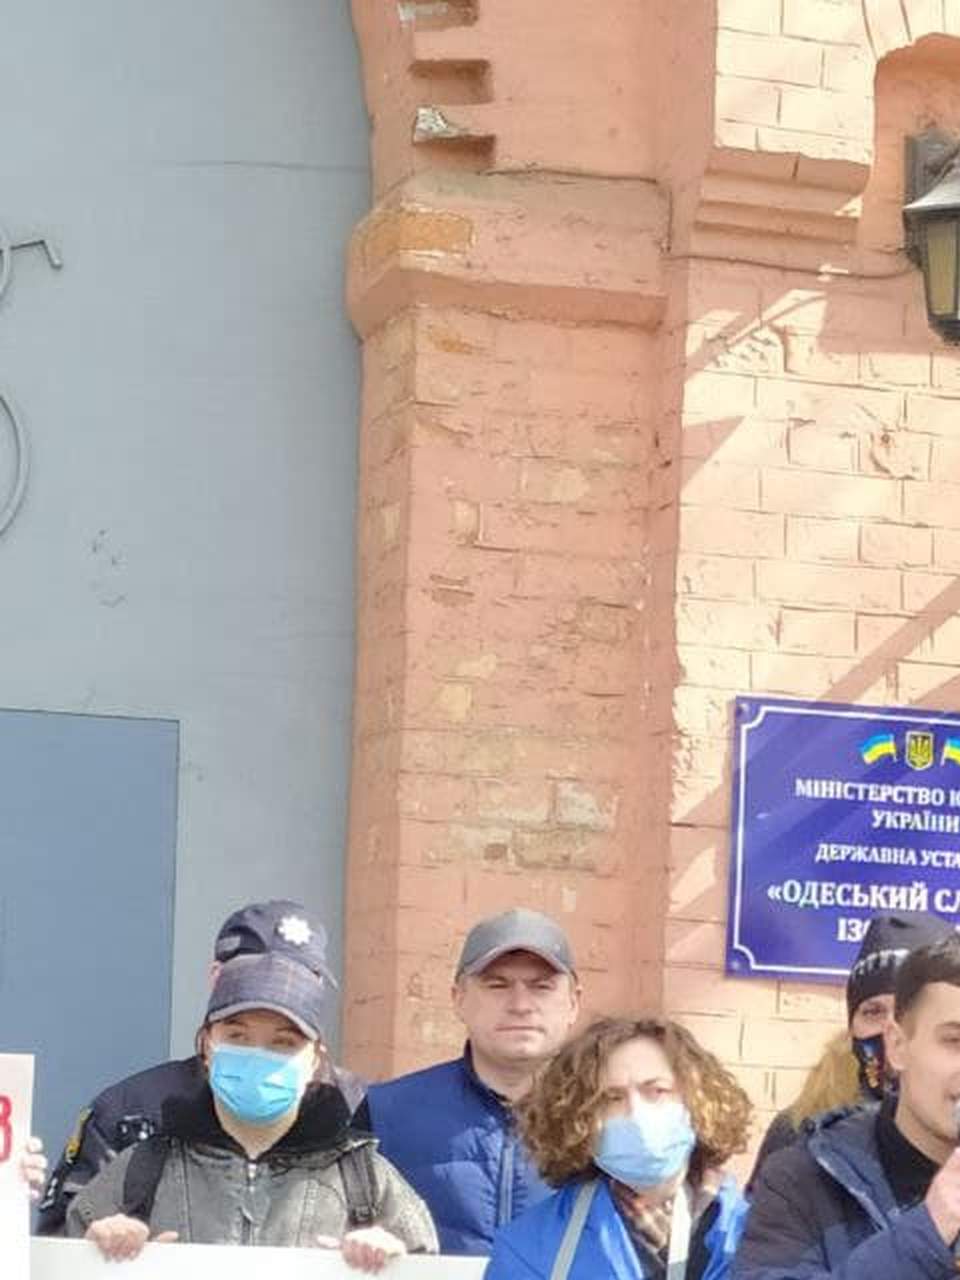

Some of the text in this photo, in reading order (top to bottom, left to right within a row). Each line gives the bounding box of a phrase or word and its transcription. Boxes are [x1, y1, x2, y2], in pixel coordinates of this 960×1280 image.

[795, 778, 945, 807] МІНІСТЕРСТВО
[871, 809, 960, 834] УКРАЇНИ
[815, 843, 917, 866] ДЕРЖАВНА
[767, 878, 929, 912] «ОДЕСЬКИЙ
